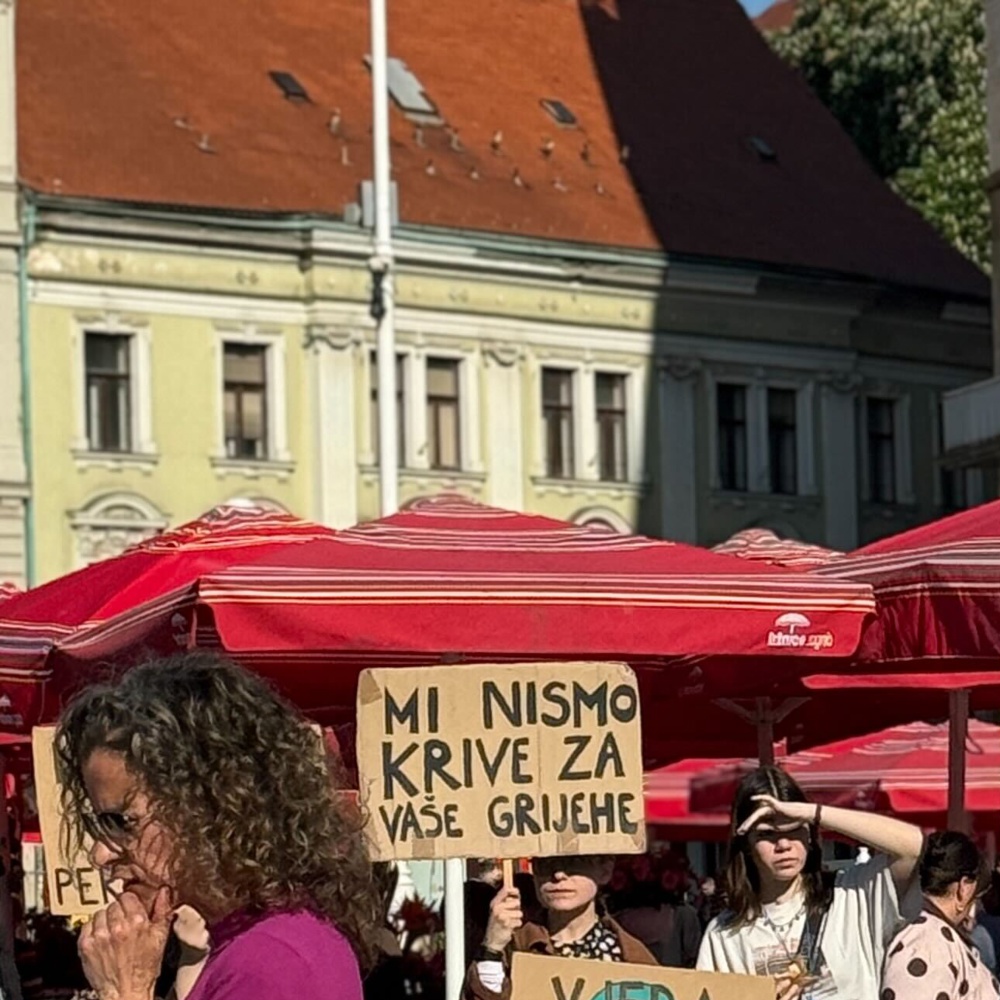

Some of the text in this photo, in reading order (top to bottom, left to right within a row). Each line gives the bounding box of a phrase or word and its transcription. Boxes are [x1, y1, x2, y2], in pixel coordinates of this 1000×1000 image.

[385, 680, 637, 734] MI NISMO
[382, 731, 625, 800] KRIVE ZA
[379, 792, 638, 844] VAŠE GRIJEHE
